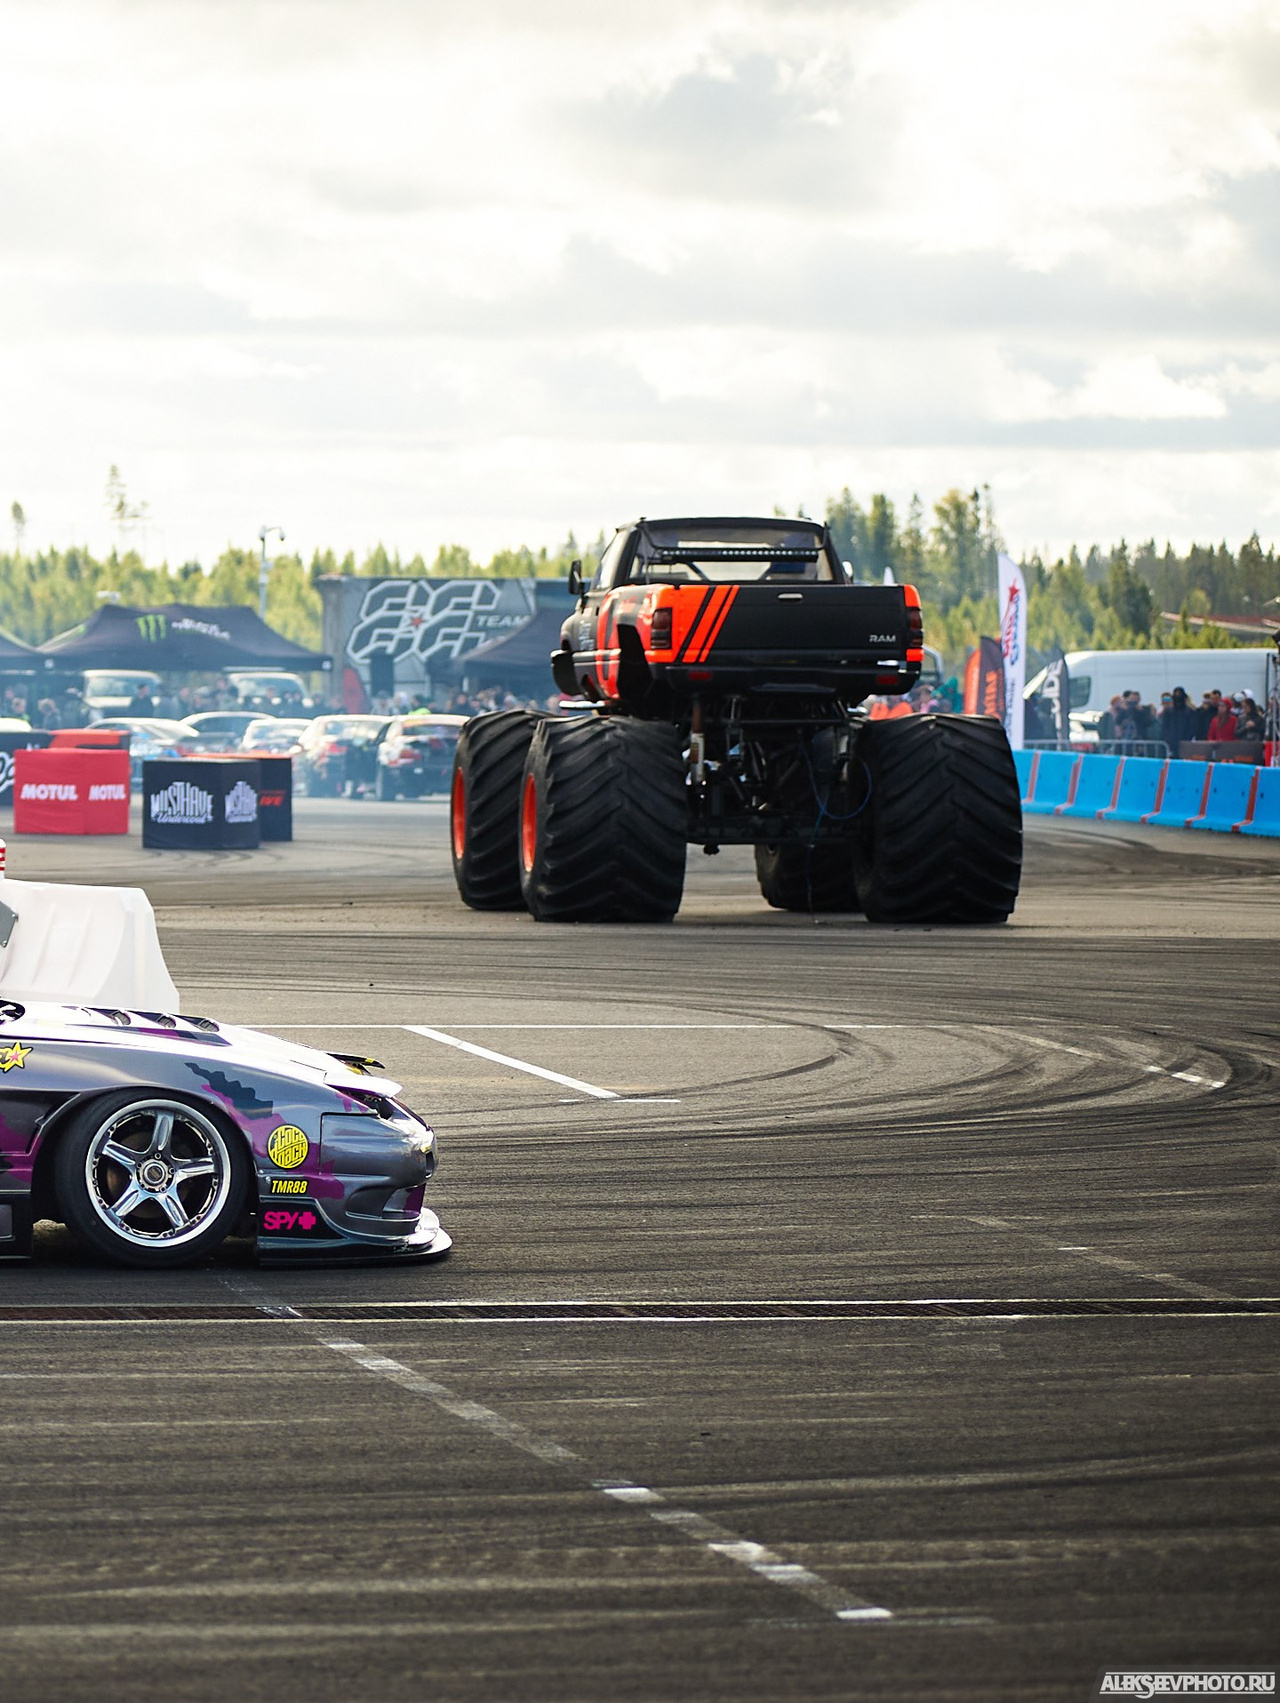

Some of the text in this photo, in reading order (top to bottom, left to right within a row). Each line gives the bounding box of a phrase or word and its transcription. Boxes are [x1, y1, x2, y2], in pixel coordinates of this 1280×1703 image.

[869, 634, 896, 643] RAM
[21, 784, 78, 801] MOTUL
[89, 784, 126, 801] MOTUL
[271, 1180, 308, 1194] TMR88
